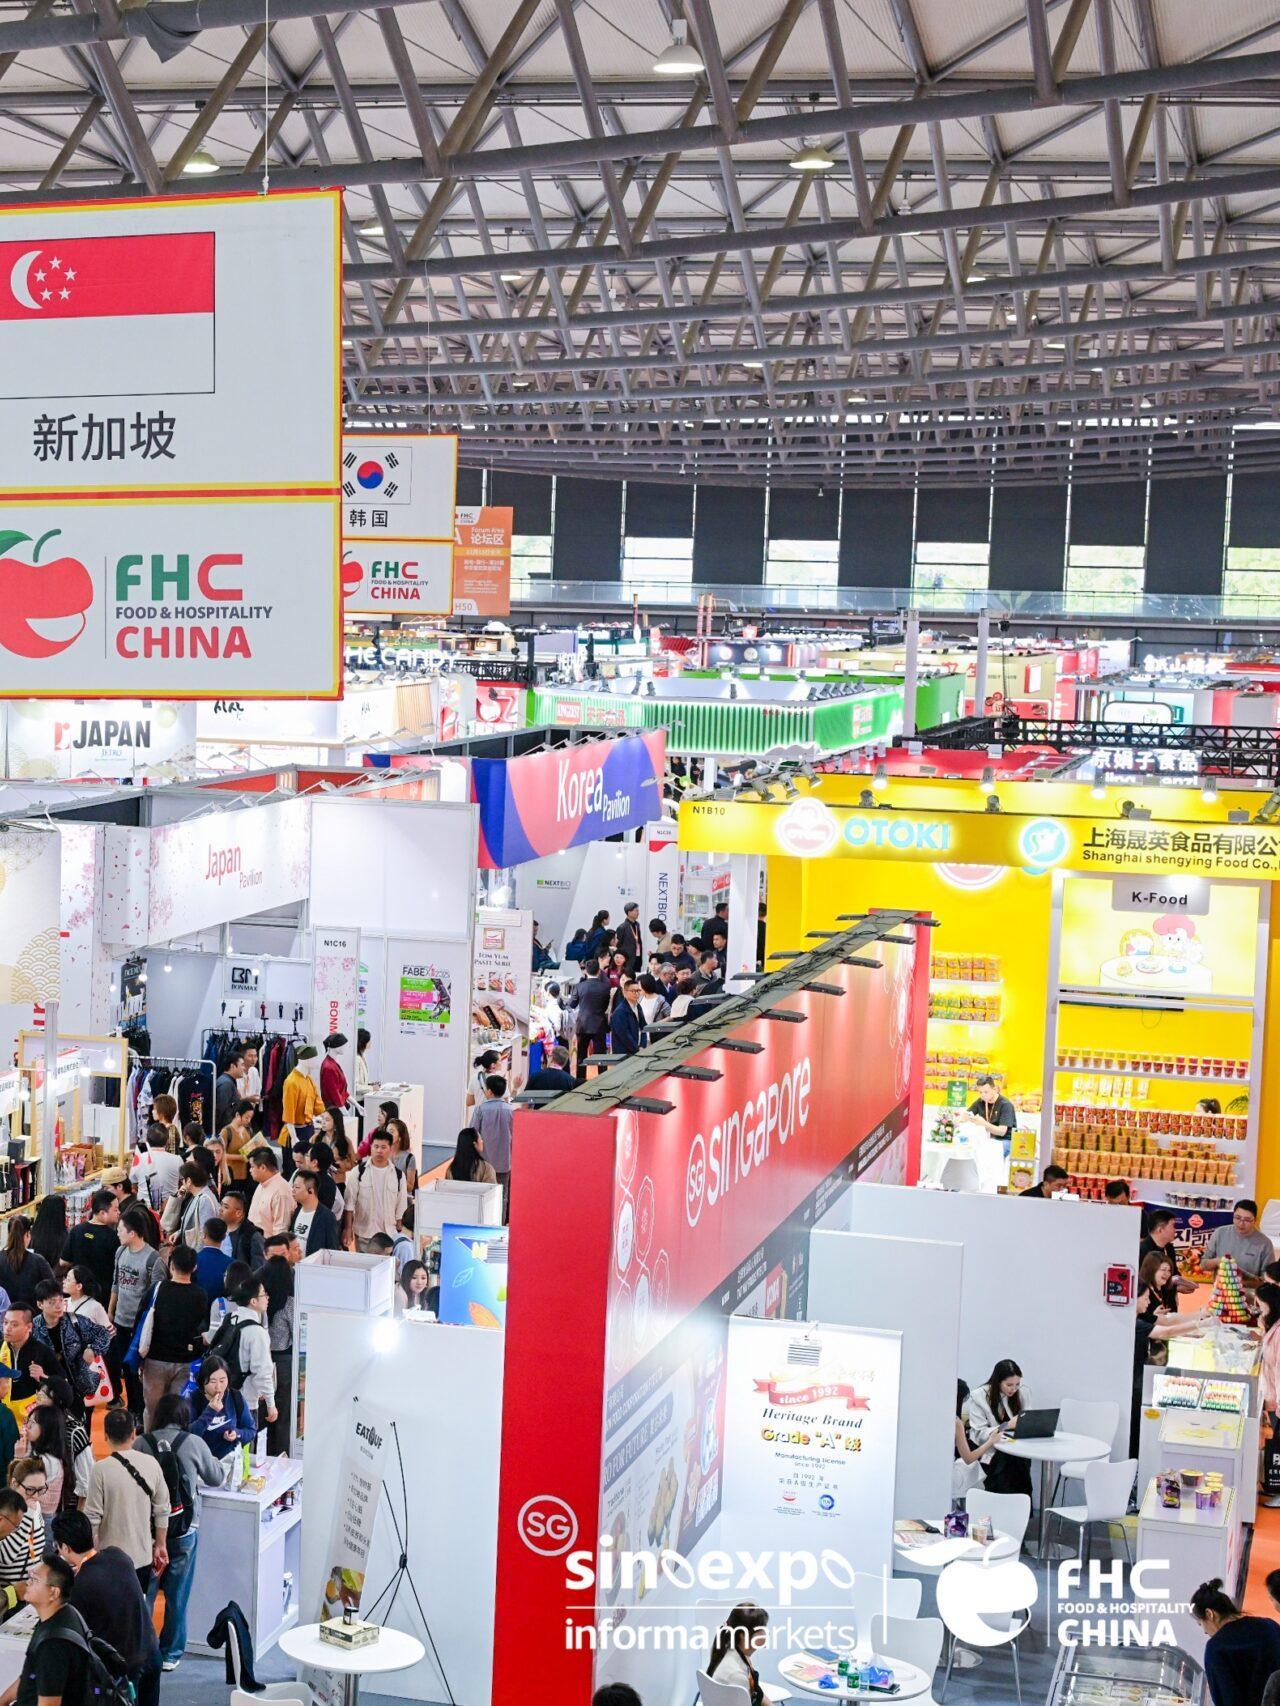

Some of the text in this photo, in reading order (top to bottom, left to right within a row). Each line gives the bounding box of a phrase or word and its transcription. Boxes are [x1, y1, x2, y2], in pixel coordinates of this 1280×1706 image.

[32, 411, 178, 464] 新加坡
[349, 509, 389, 528] 韩国
[470, 533, 505, 545] 论坛区
[116, 553, 244, 602] FHC
[371, 561, 419, 580] FHC
[371, 587, 421, 600] CHINA
[116, 605, 273, 621] FOOD & HOSPITALITY
[117, 623, 252, 660] CHINA
[73, 720, 151, 749] JAPAN
[556, 757, 604, 823] Korea
[602, 790, 631, 823] Pavilion
[692, 805, 726, 816] N1B10
[843, 817, 951, 850] OTOKI
[1083, 827, 1280, 857] 上海晟英食品有限公
[205, 844, 241, 886] Japan
[1083, 850, 1280, 872] Shanghai shengying Food Co.,
[239, 868, 263, 889] Pavilion
[1131, 891, 1189, 906] K-Food
[323, 939, 347, 949] N1C16
[231, 984, 258, 992] BONMAX
[329, 1000, 340, 1036] BONM
[688, 1156, 707, 1198] SG
[779, 1386, 840, 1404] since 1992
[762, 1408, 863, 1429] Heritage Brand
[762, 1429, 811, 1446] Grade
[526, 1510, 571, 1541] SG
